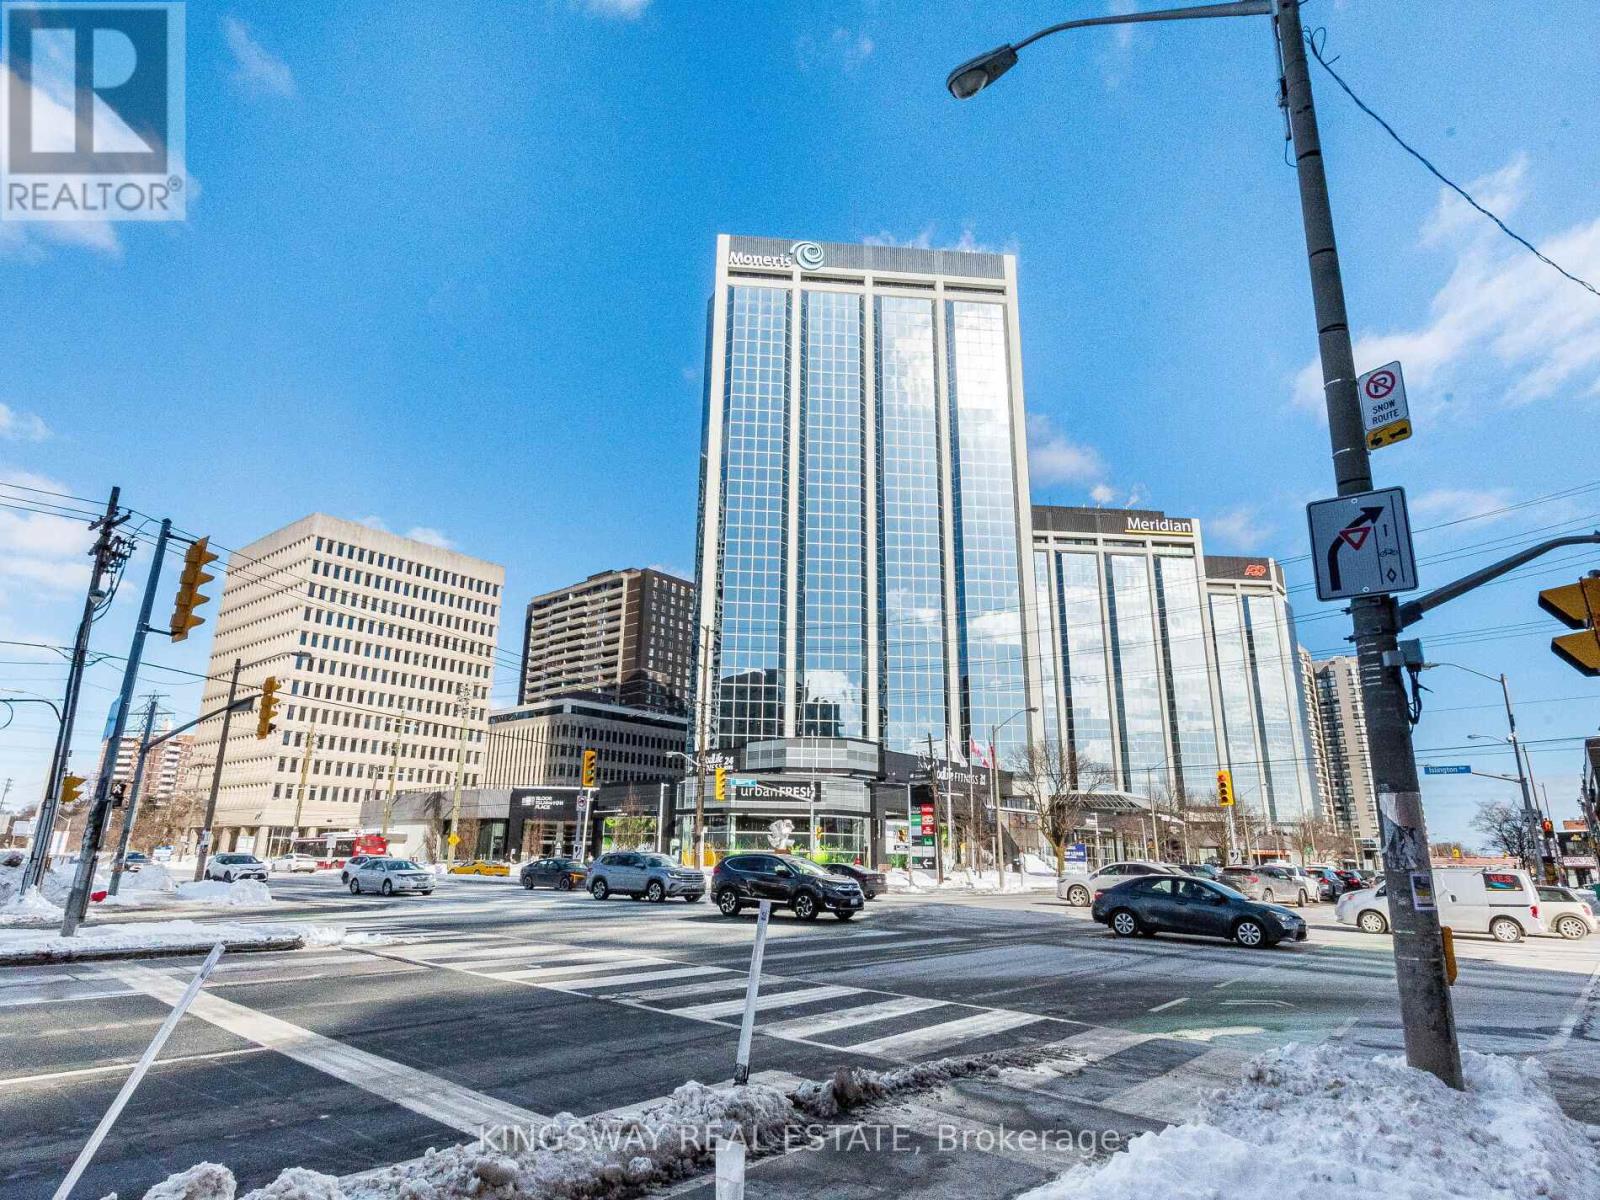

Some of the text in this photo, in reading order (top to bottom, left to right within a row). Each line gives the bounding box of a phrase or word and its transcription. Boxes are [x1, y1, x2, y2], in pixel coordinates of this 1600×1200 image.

[729, 251, 792, 267] Moneris
[1372, 400, 1395, 414] SNOW
[1372, 409, 1399, 425] ROUTE
[1126, 517, 1192, 532] Meridian
[1429, 767, 1458, 775] Islington
